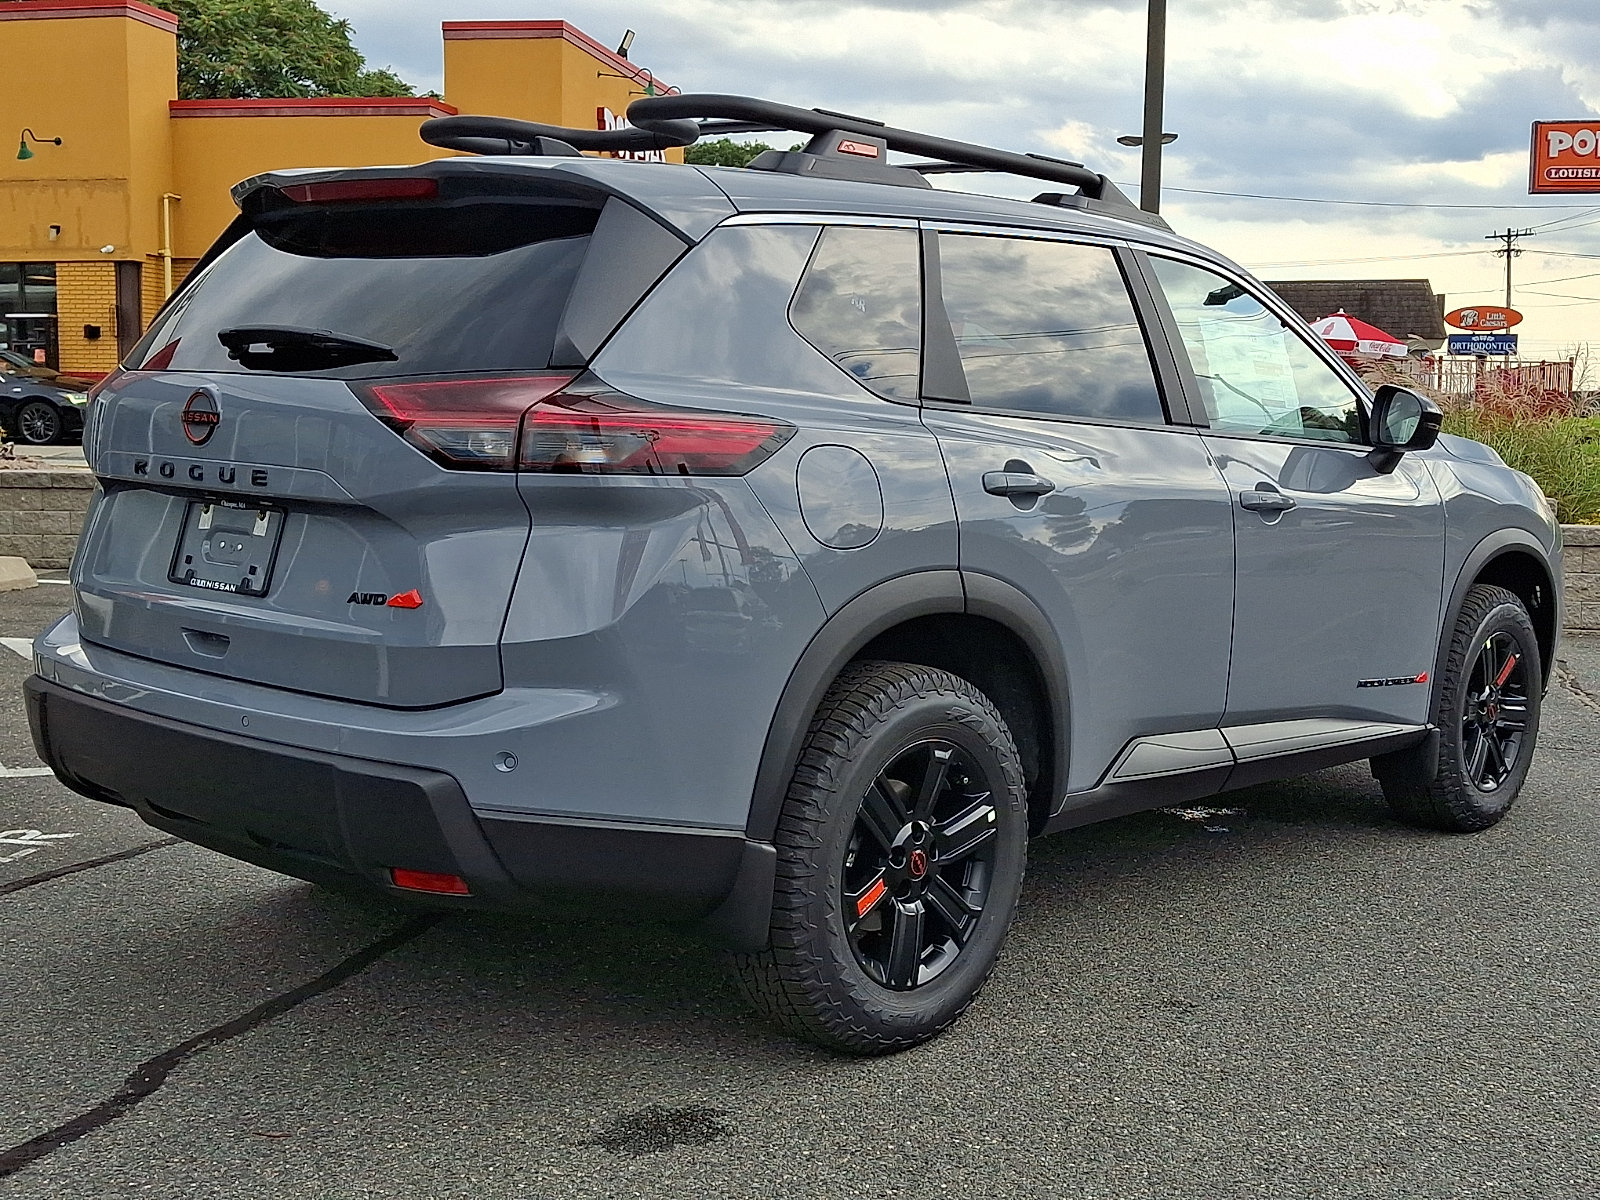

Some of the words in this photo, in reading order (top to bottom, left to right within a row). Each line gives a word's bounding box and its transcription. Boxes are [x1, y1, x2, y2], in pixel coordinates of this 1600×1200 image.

[1546, 129, 1600, 159] PO
[1486, 312, 1506, 320] Little
[1450, 341, 1516, 351] ORTHODONTICS
[134, 460, 268, 486] ROGUE
[346, 592, 388, 606] AWD
